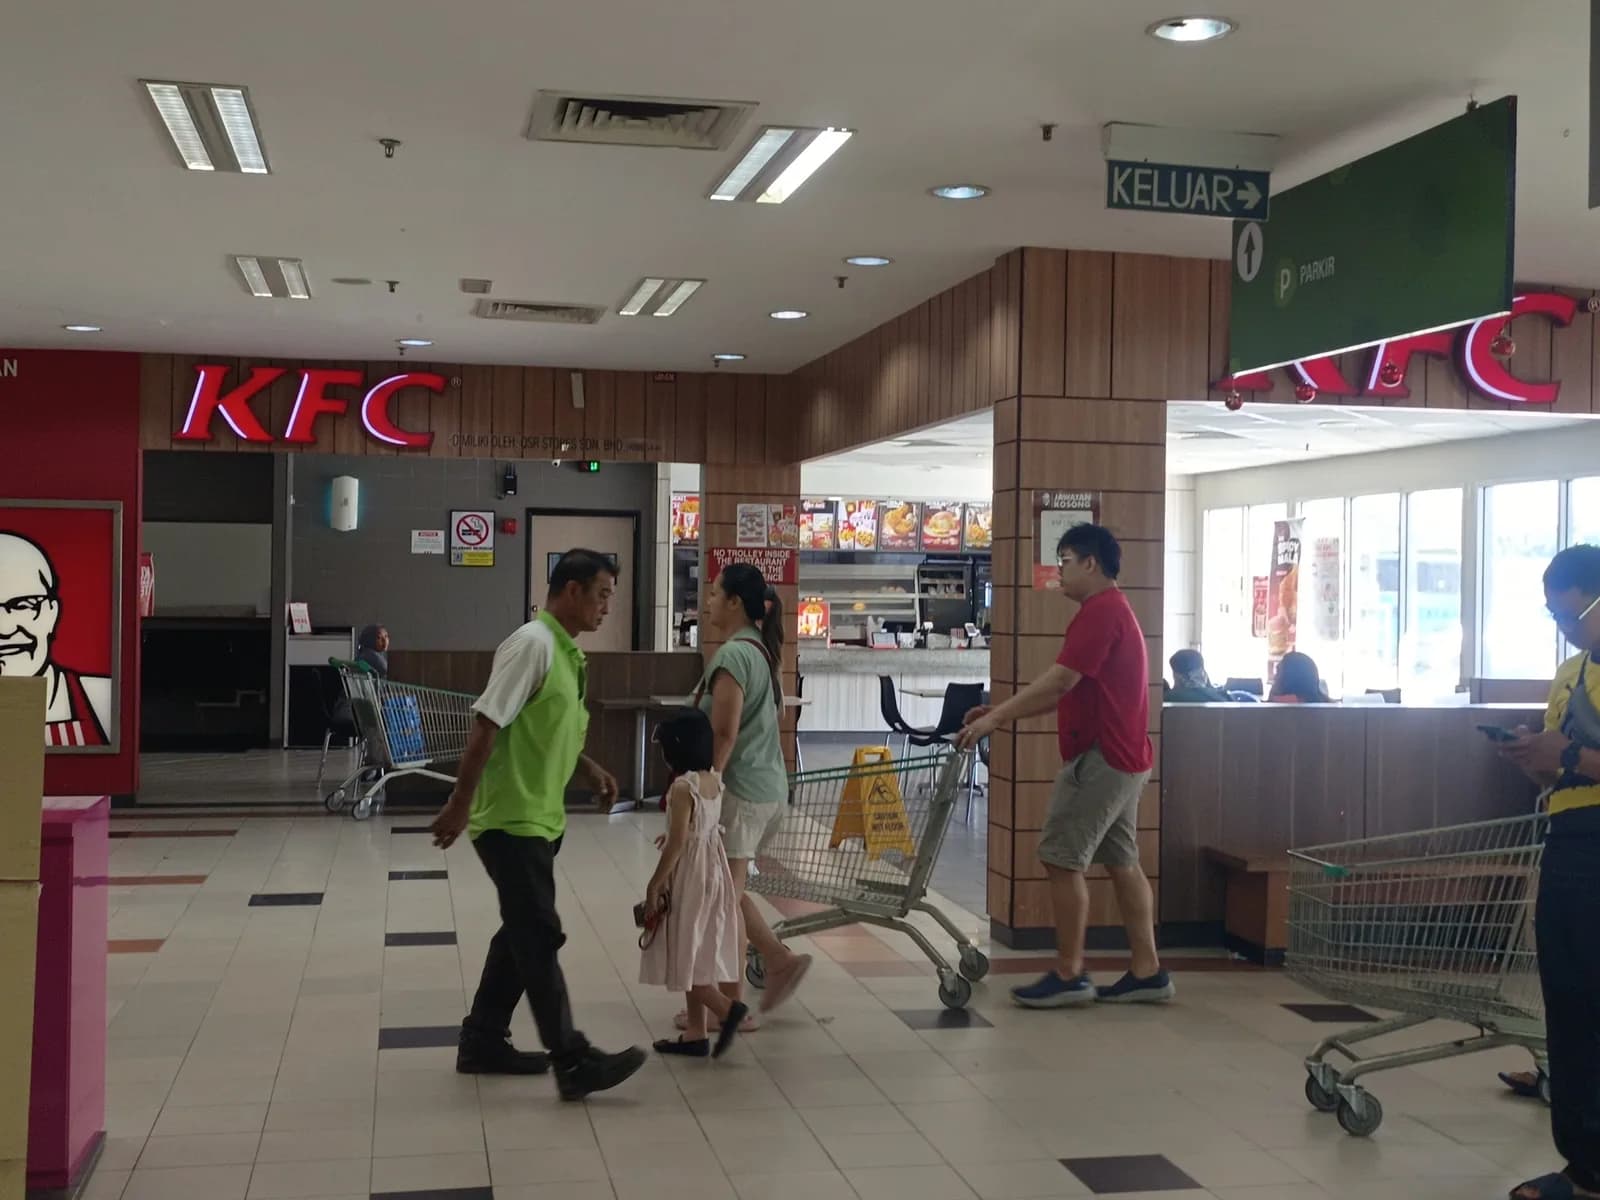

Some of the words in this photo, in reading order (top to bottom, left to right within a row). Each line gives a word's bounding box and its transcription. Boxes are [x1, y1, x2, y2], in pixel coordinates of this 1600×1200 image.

[1112, 166, 1234, 212] KELUAR
[1300, 255, 1335, 285] PARKIR
[172, 364, 448, 449] KFC
[1054, 493, 1092, 501] JAWATAN
[1053, 500, 1091, 508] KOSONG
[713, 549, 726, 557] NO
[727, 549, 763, 558] TROLLEY
[765, 550, 791, 559] INSIDE
[717, 557, 732, 566] THE
[768, 566, 783, 574] THE
